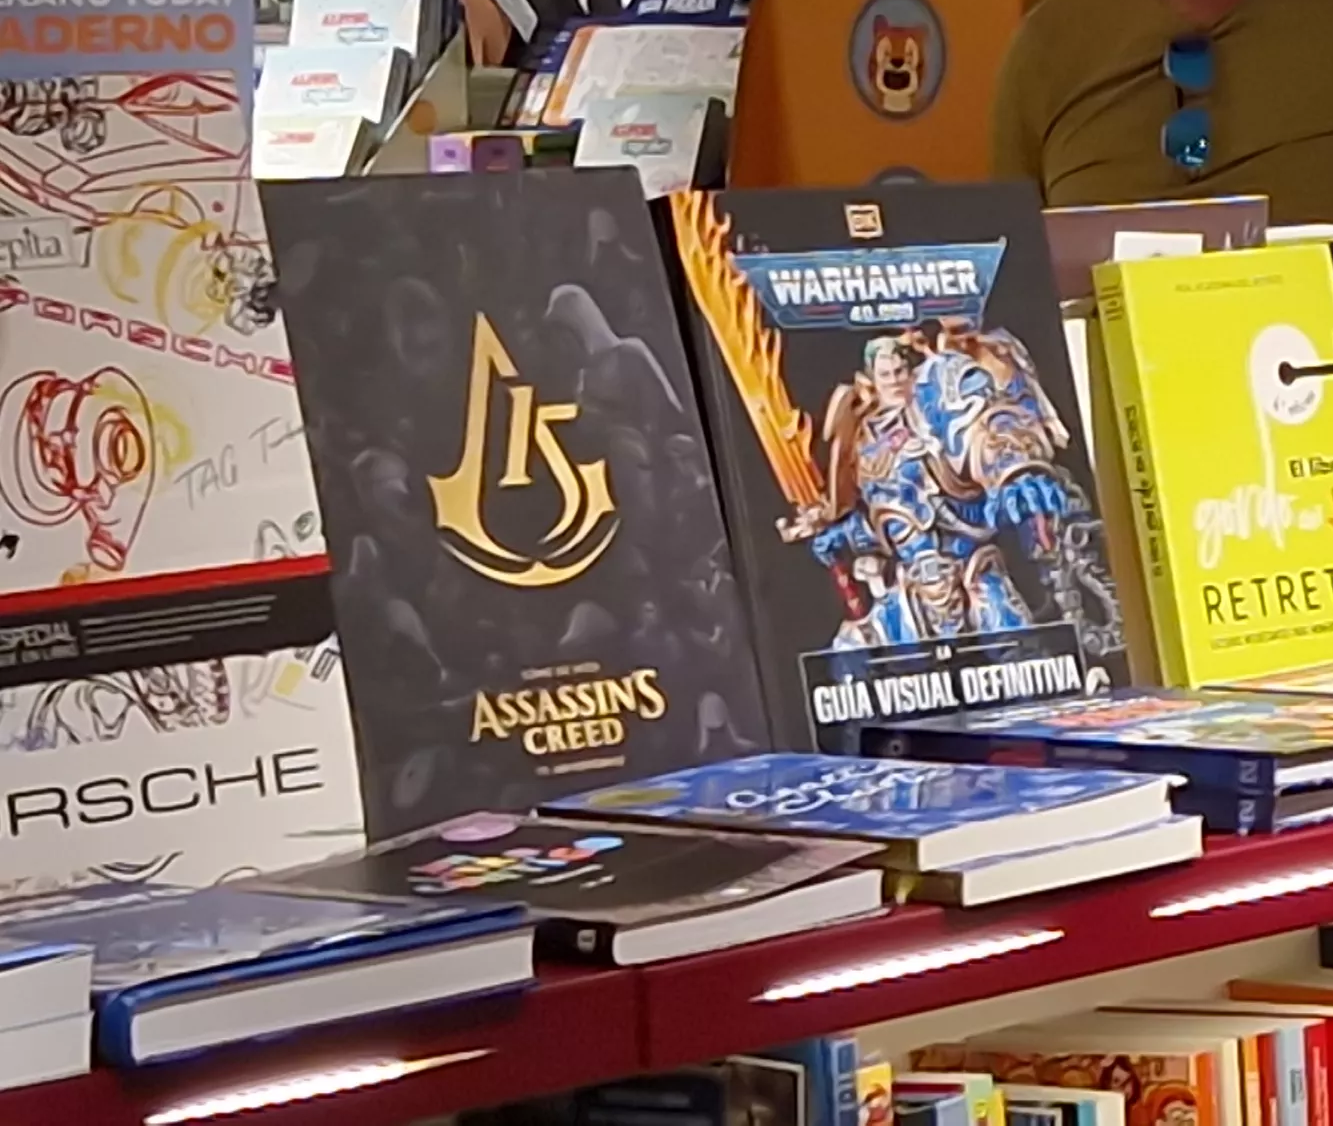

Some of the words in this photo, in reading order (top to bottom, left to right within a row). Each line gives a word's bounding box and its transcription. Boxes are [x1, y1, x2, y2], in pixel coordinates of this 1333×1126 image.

[768, 259, 981, 306] WARHAMMER
[813, 674, 875, 724] GUÍA
[873, 672, 960, 717] VISUAL
[960, 654, 1082, 706] DEFINITIVA
[523, 718, 626, 756] CREED
[7, 747, 324, 837] RSCHE
